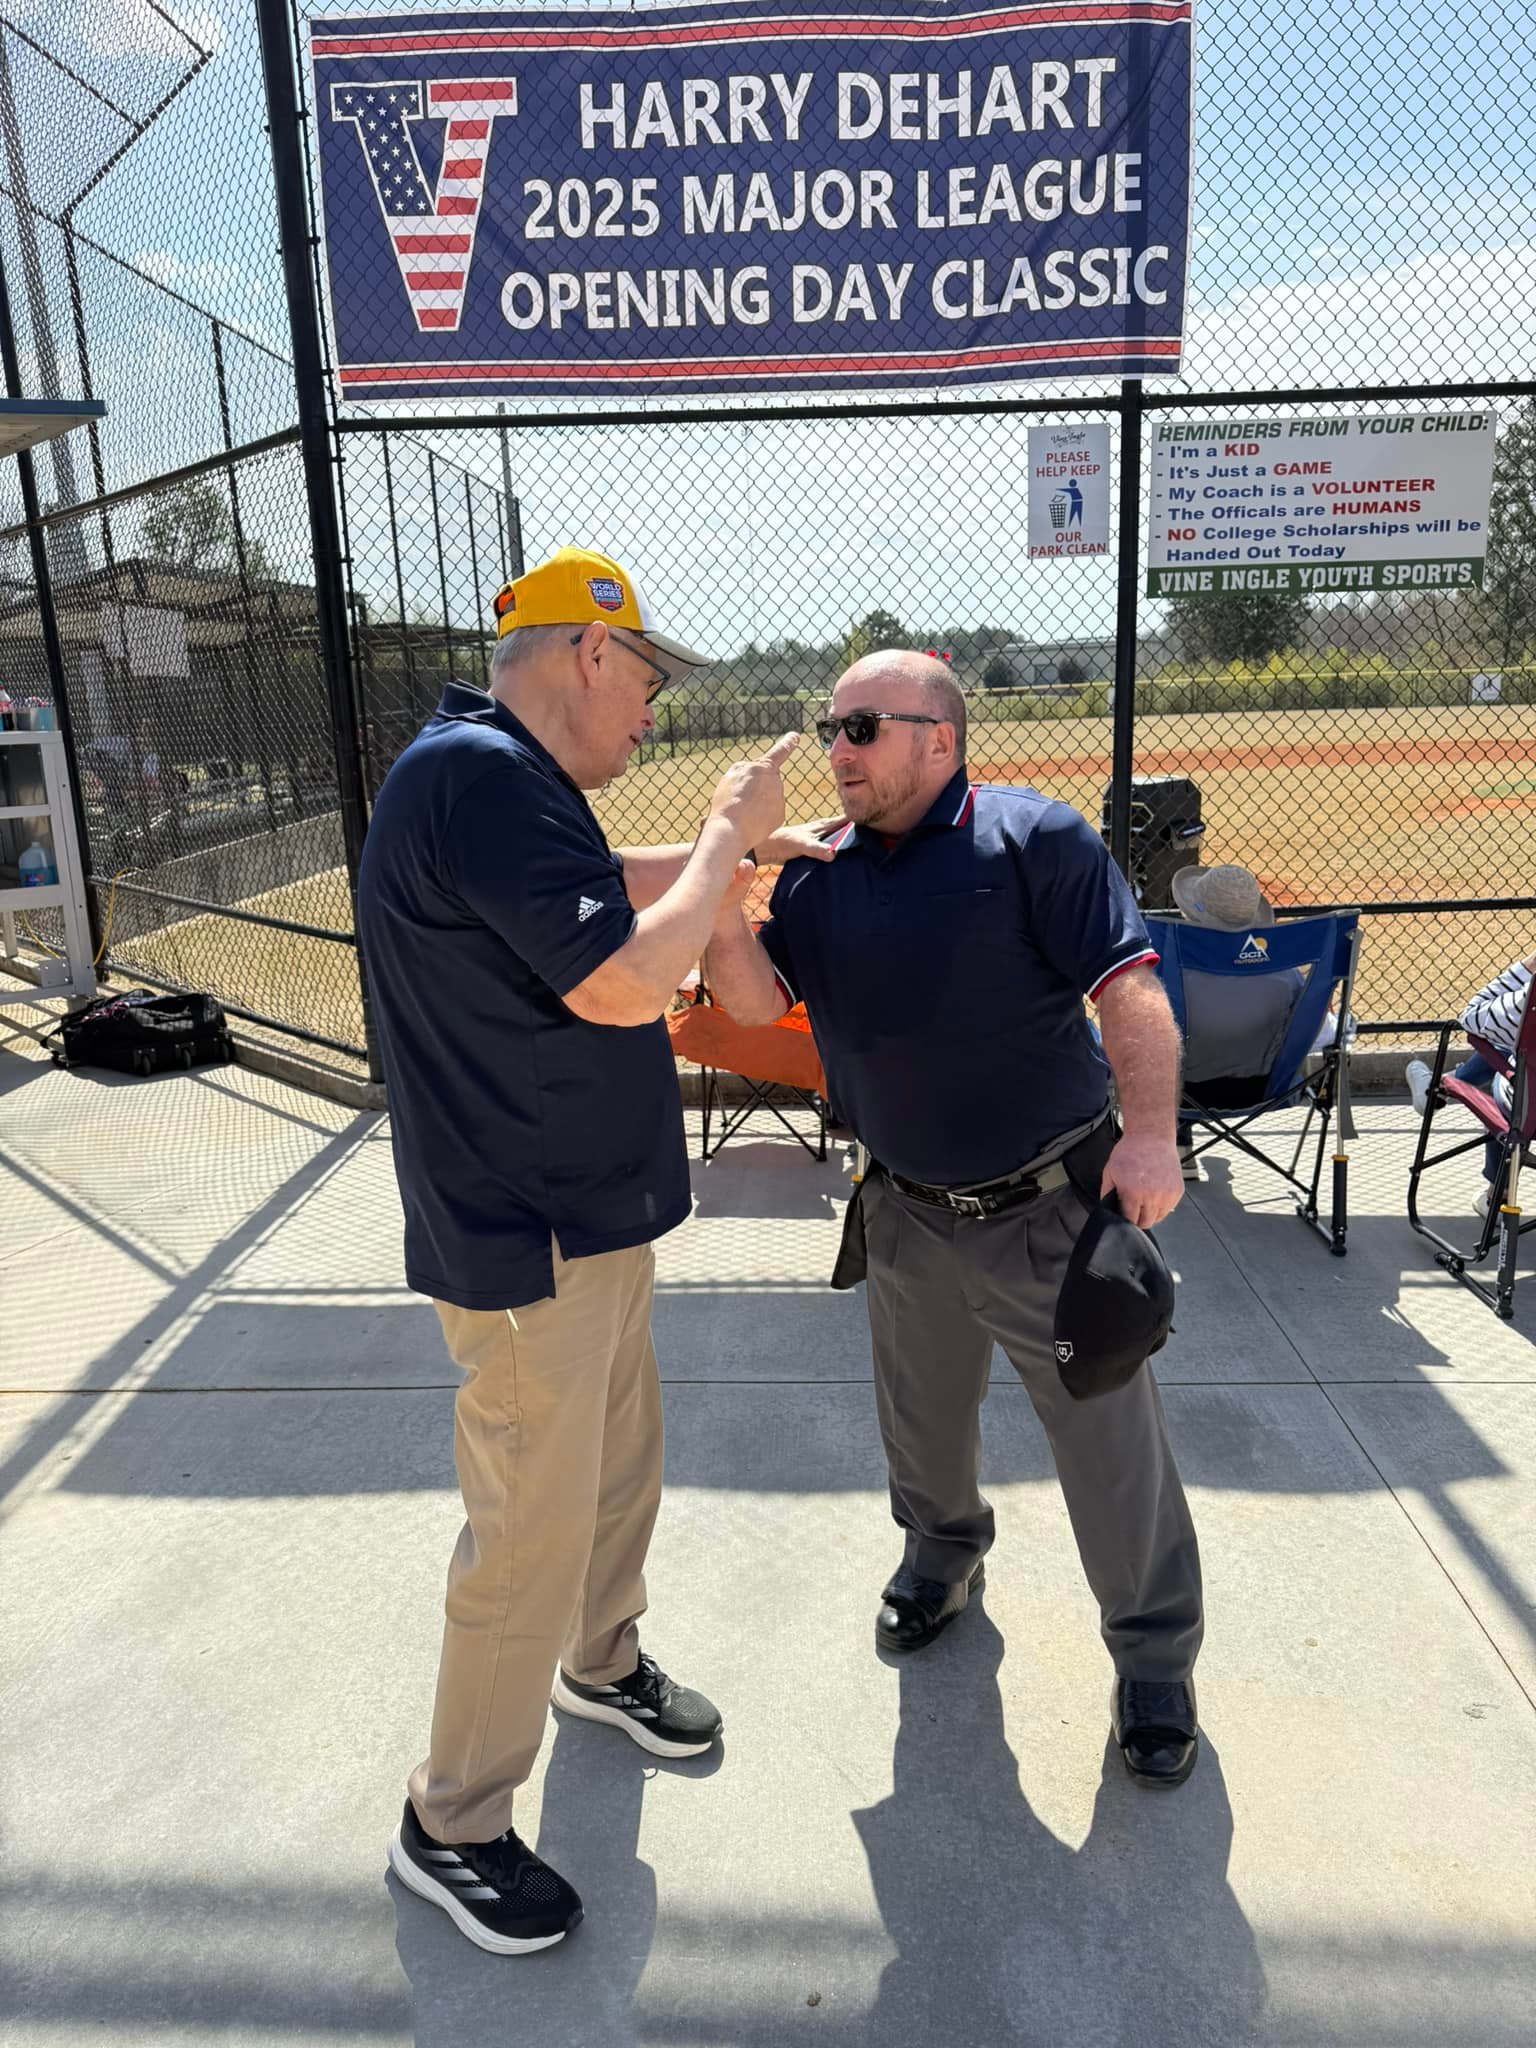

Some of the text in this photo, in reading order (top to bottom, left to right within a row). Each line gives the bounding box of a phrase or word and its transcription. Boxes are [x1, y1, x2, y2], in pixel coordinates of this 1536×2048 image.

[579, 57, 1116, 149] HARRY DEHART
[523, 153, 1142, 239] 2025 MAJOR LEAGUE
[501, 245, 1168, 330] OPENING DAY CLASSIC
[1158, 414, 1488, 442] REMINDERS FROM YOUR CHILD:
[1046, 451, 1090, 463] PLEASE
[1170, 443, 1260, 458] I'm a KID
[1036, 464, 1101, 478] HELP KEEP
[1170, 461, 1332, 479] It's Just a GAME
[1169, 479, 1435, 502] My Coach is a VOLUNTEER
[1168, 500, 1421, 521] The Officals are HUMANS
[1055, 531, 1082, 543] OUR
[1167, 519, 1481, 541] NO College Scholarships will be
[1031, 543, 1106, 557] PARK CLEAN
[1167, 544, 1346, 562] Handed Out Today
[1159, 562, 1472, 592] VINE INGLE YOUTH SPORTS
[590, 582, 622, 591] WORLD
[592, 590, 622, 598] SERIES
